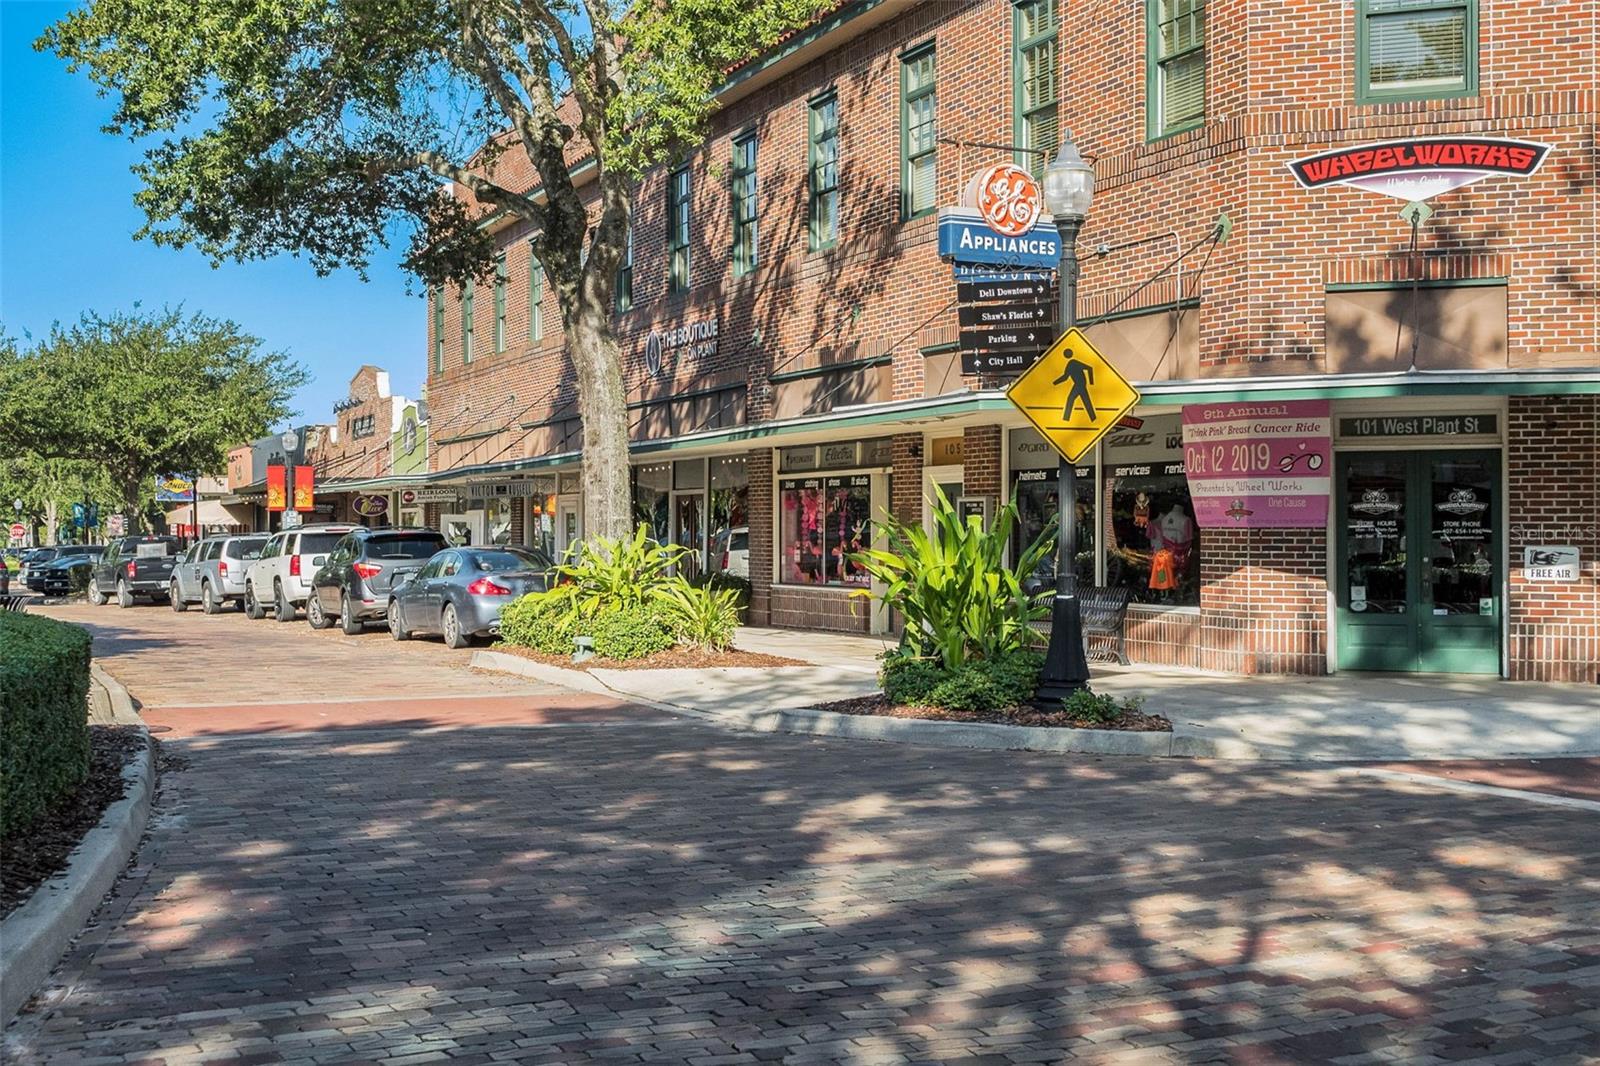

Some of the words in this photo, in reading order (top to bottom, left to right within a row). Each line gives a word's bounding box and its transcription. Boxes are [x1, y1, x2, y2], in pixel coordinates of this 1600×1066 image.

[1301, 143, 1537, 182] WHEELWORKS
[997, 286, 1033, 296] Downtown
[981, 312, 1007, 321] Shaw's
[1008, 311, 1034, 320] Florist
[662, 328, 677, 348] THE
[677, 318, 718, 345] BOUTIQUE
[987, 334, 1018, 344] Parking
[697, 340, 718, 357] PLANT
[988, 357, 1005, 367] City
[1006, 355, 1023, 365] Hall
[1203, 408, 1225, 420] 9th
[1226, 405, 1289, 418] Annual
[1227, 425, 1251, 435] Breast
[1253, 423, 1293, 434] Cancer
[1295, 421, 1321, 433] Ride
[1354, 419, 1378, 434] 101
[1383, 418, 1419, 434] West
[1422, 417, 1460, 434] Plant
[1464, 416, 1479, 433] St
[944, 442, 961, 455] 105
[1187, 446, 1206, 473] Oct
[1211, 445, 1225, 472] 12
[1231, 442, 1271, 472] 2019
[1018, 469, 1047, 481] helmets
[1115, 464, 1150, 477] services
[1196, 482, 1225, 493] Presented
[1225, 481, 1234, 493] by
[1235, 480, 1265, 492] Wheel
[1267, 480, 1303, 492] Works
[1461, 520, 1481, 528] PHONE
[1530, 568, 1553, 578] FREE
[1555, 569, 1571, 578] AIR
